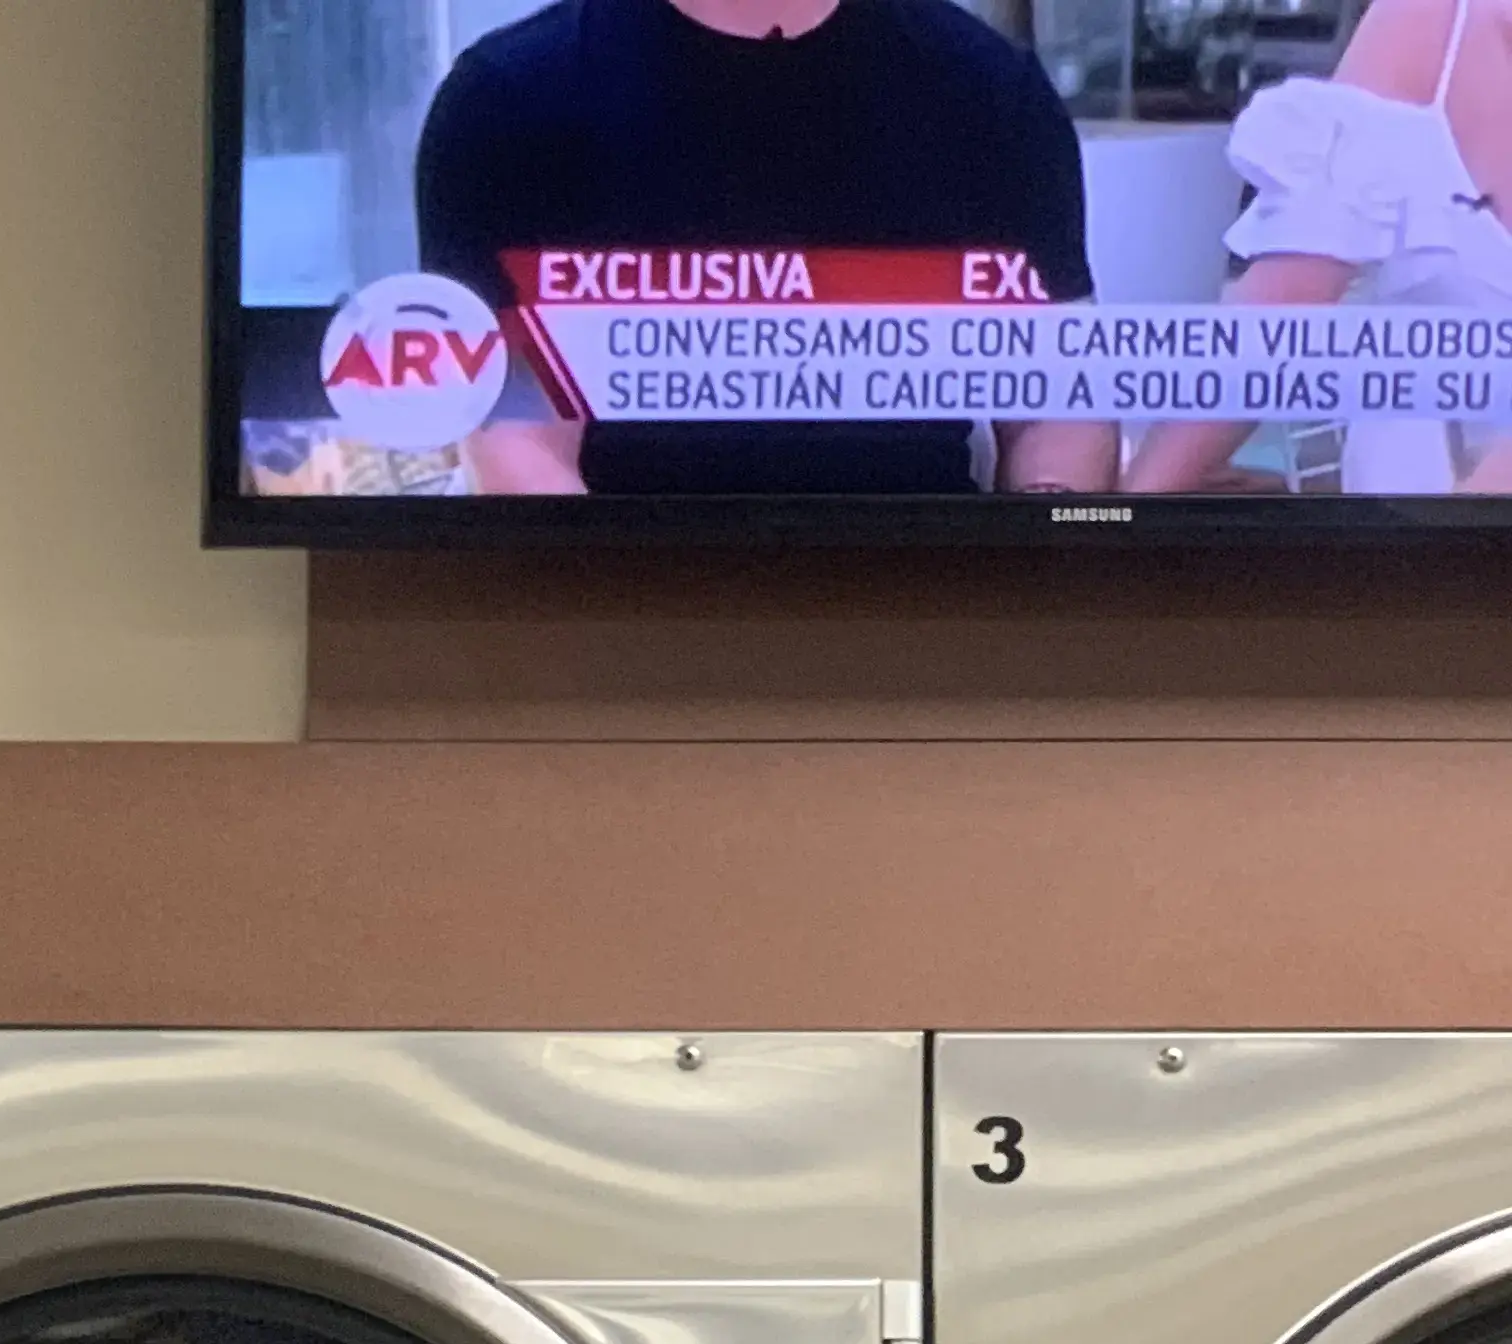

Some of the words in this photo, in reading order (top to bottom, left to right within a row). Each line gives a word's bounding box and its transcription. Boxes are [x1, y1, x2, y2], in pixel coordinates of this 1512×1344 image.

[538, 252, 814, 299] EXCLUSIVA
[324, 330, 506, 387] ARV
[608, 318, 929, 358] CONVERSAMOS
[952, 318, 1034, 357] CON
[1058, 318, 1238, 357] CARMEN
[1260, 318, 1512, 358] VILLALOBOS
[608, 361, 842, 409] SEBASTIÁN
[866, 370, 1048, 409] CAICEDO
[1067, 371, 1093, 409] A
[1113, 370, 1221, 409] SOLO
[1244, 362, 1339, 410] DÍAS
[1362, 372, 1416, 410] DE
[1436, 372, 1490, 411] SU
[1052, 508, 1132, 522] SAMSUNG
[972, 1116, 1025, 1184] 3
